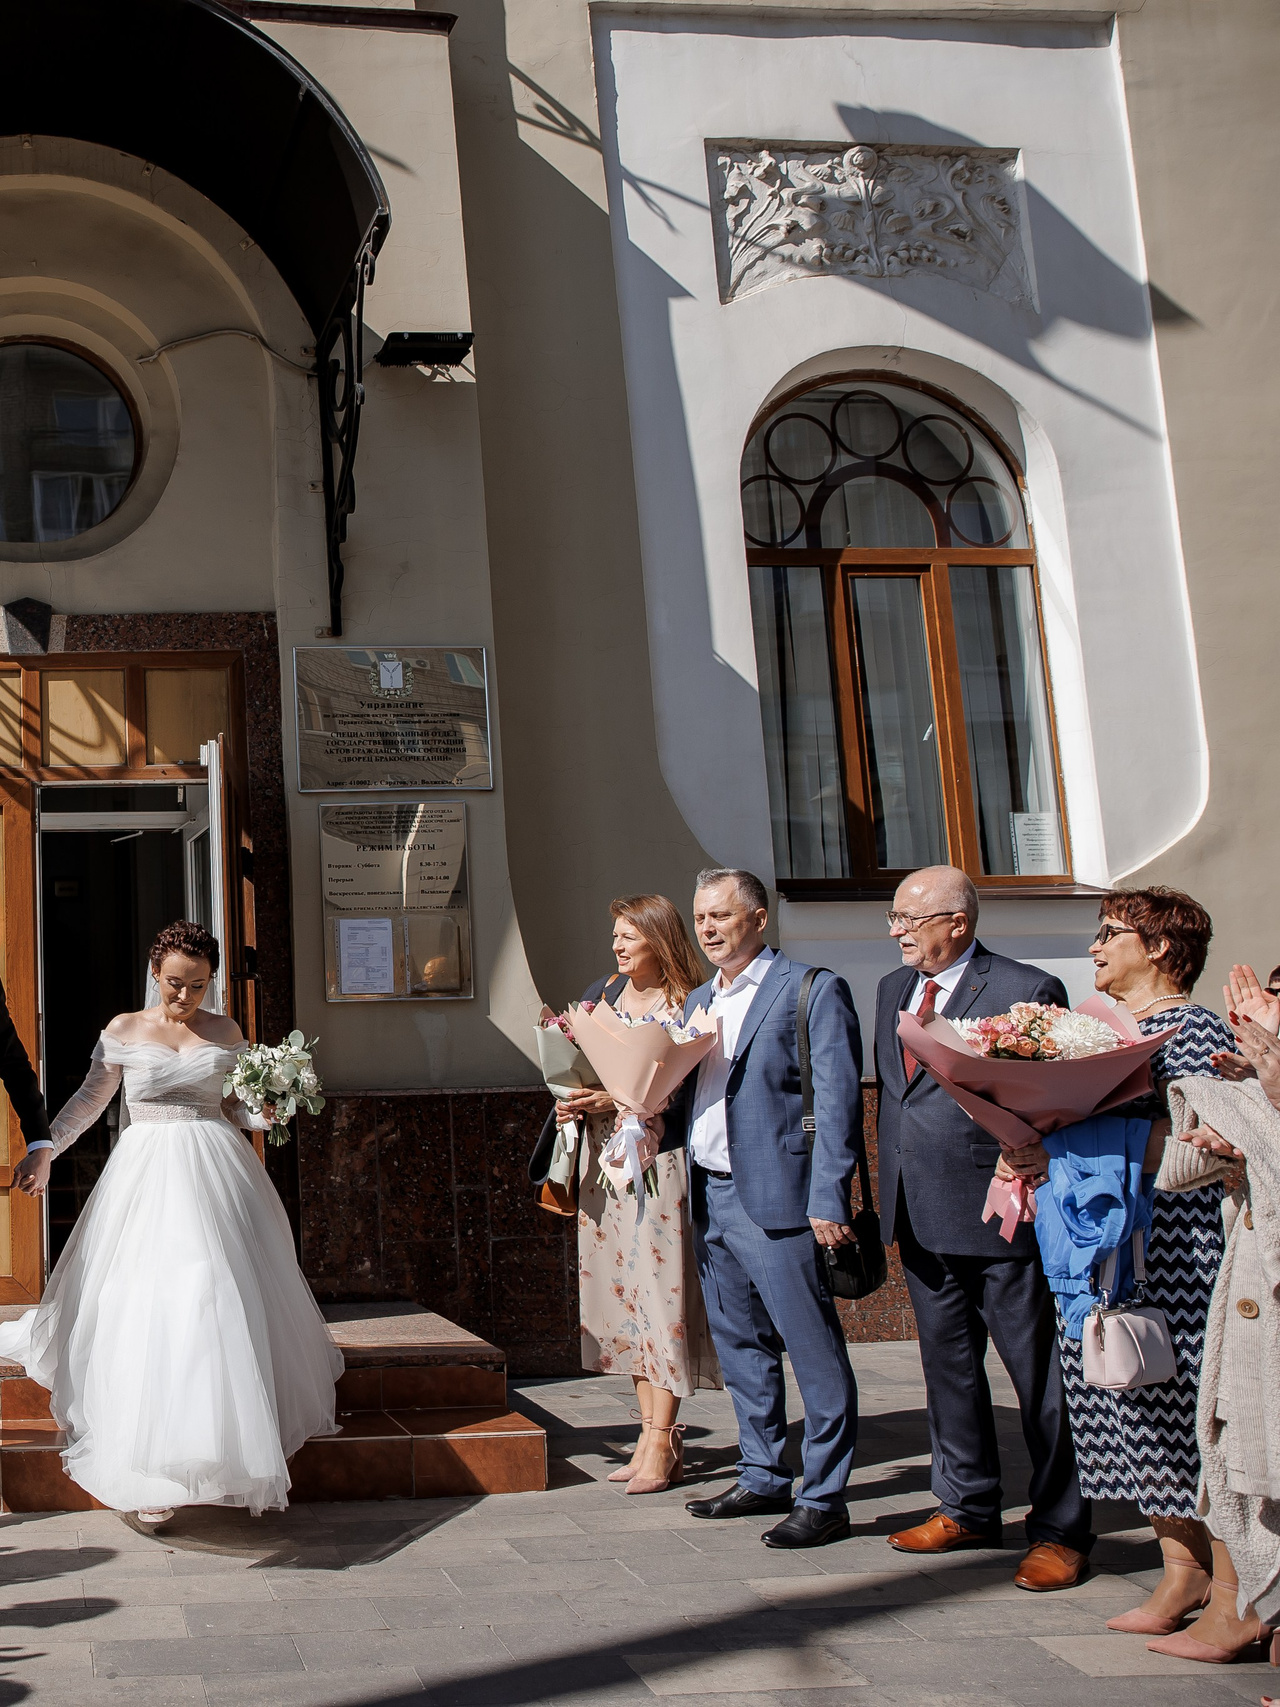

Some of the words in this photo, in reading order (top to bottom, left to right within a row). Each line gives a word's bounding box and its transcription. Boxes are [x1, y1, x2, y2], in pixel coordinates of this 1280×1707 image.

[359, 700, 424, 711] Управление
[407, 738, 464, 746] РЕГИСТРАЦИИ
[323, 747, 351, 755] АКТОВ
[352, 747, 417, 755] ГРАЖДАНСКОГО
[356, 844, 392, 852] РЕЖИМ
[395, 843, 436, 851] РАБОТЫ
[357, 862, 380, 870] Суббота
